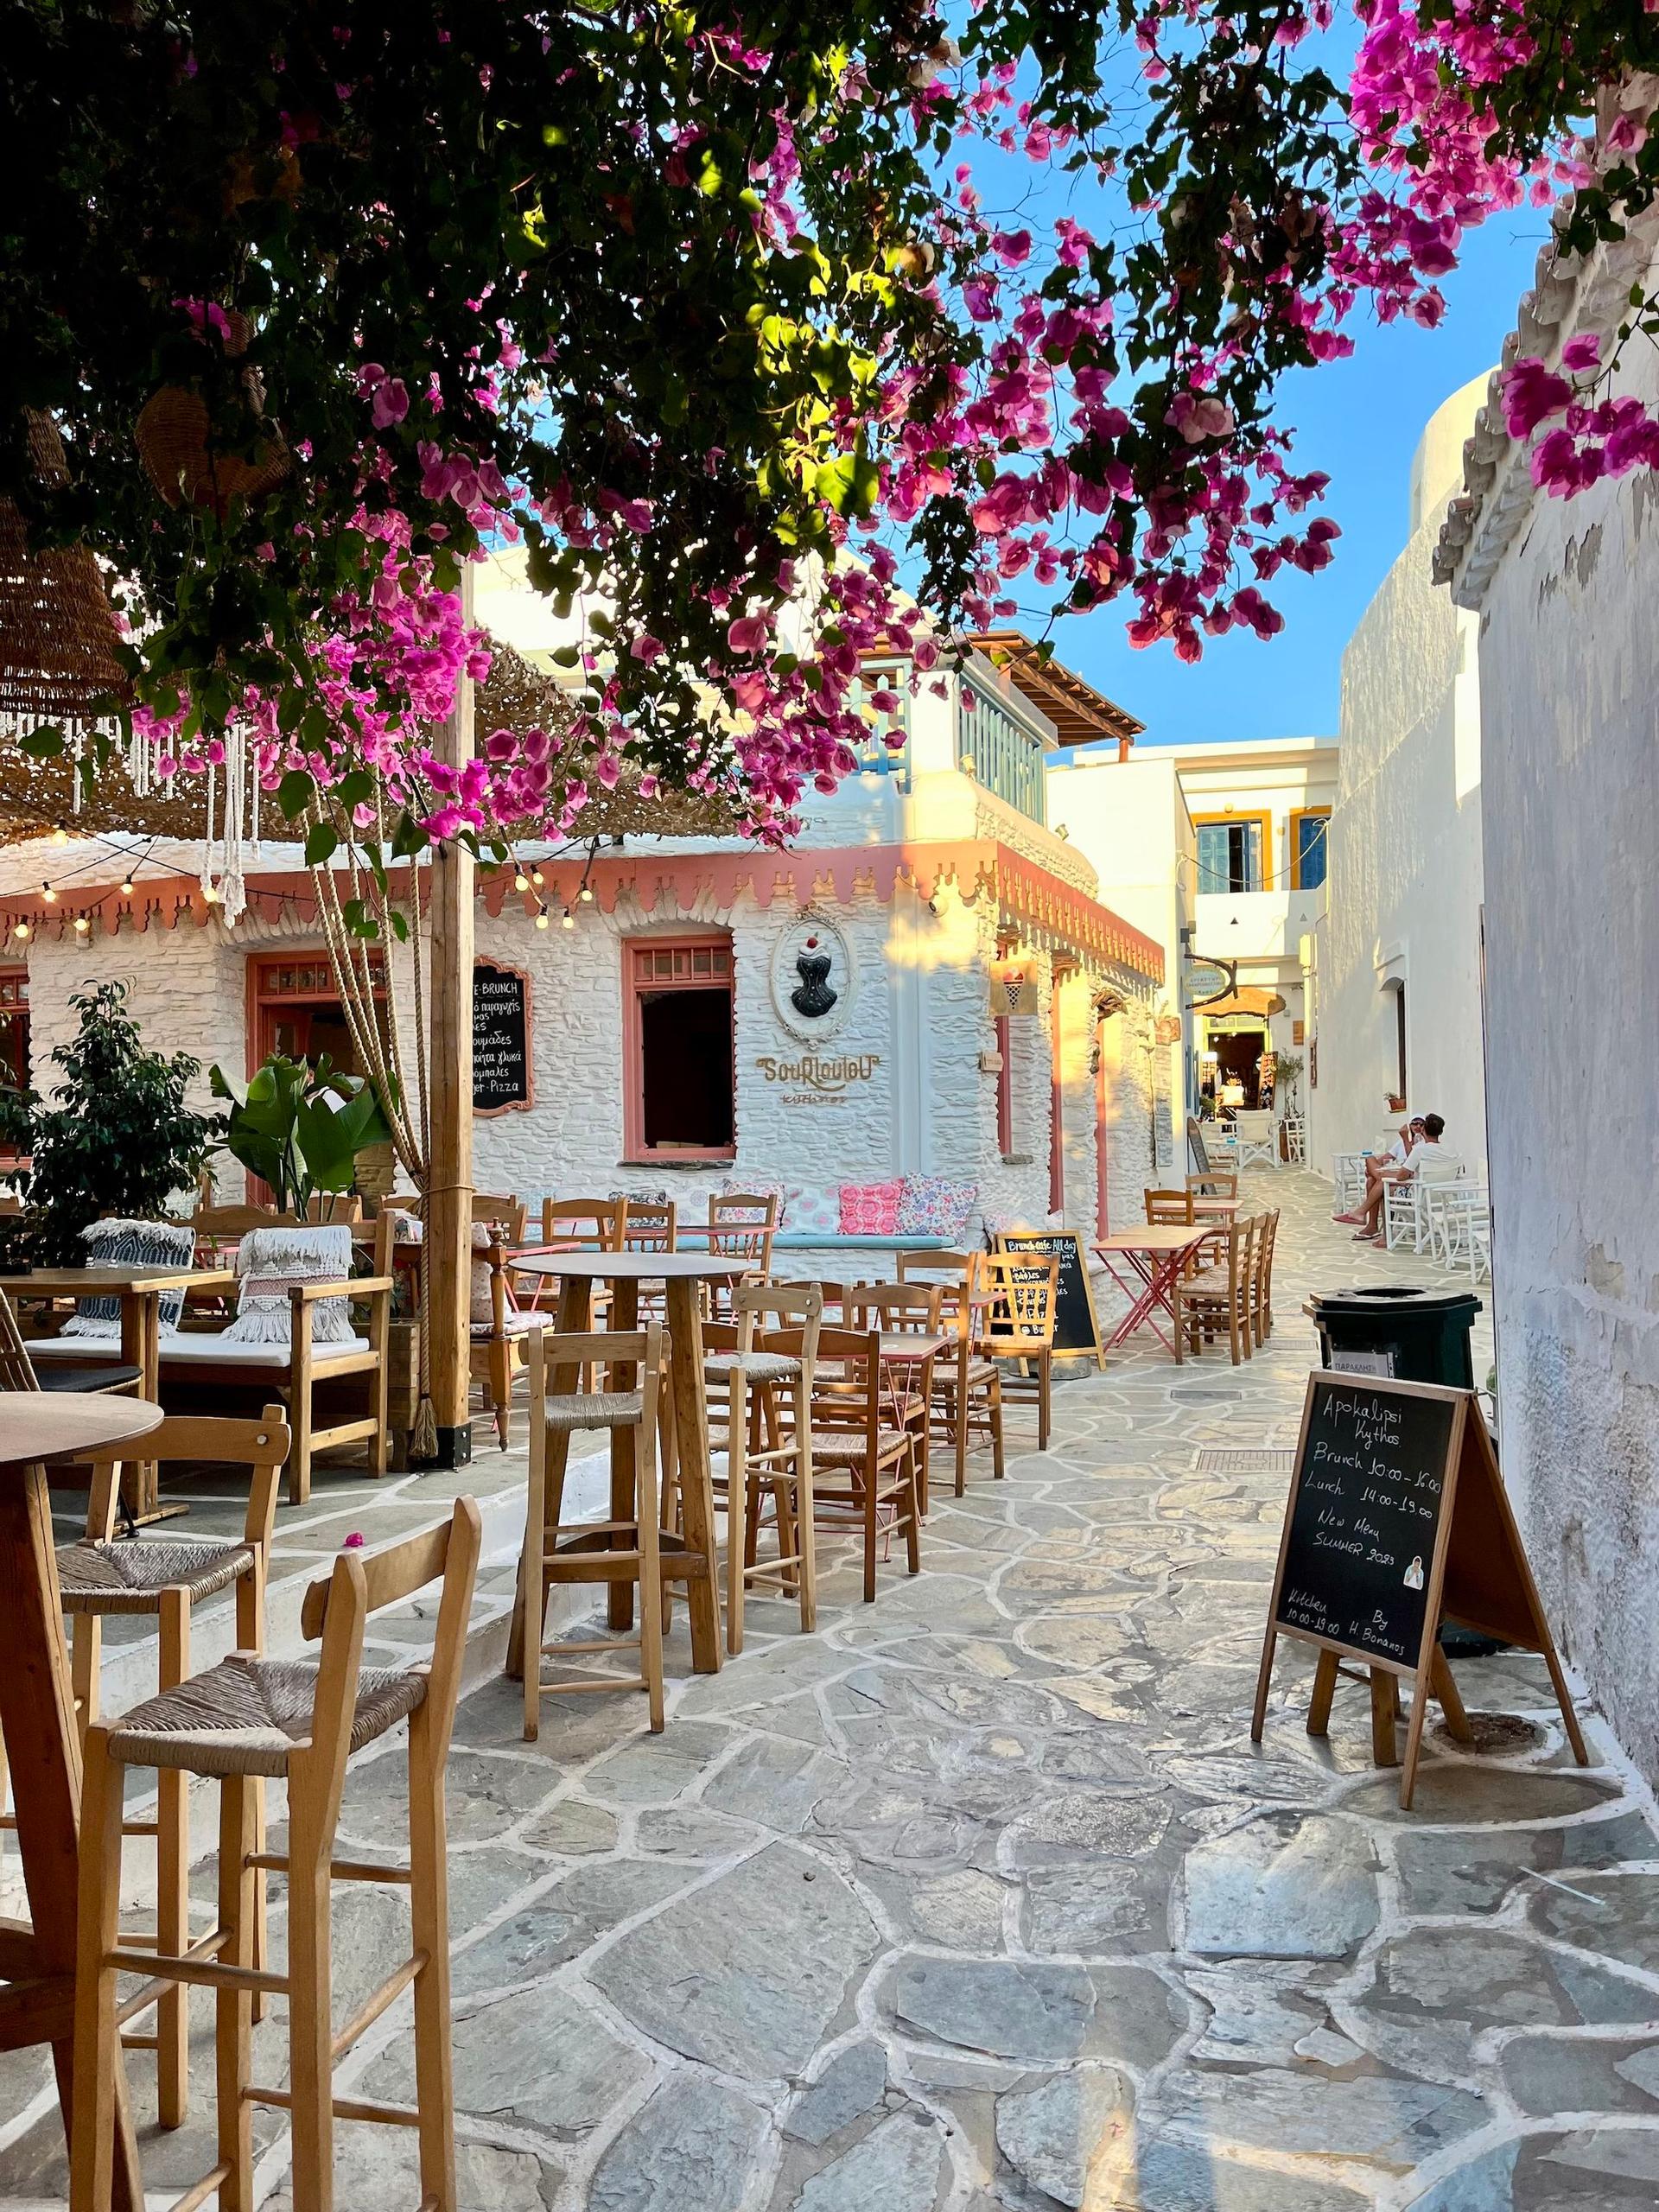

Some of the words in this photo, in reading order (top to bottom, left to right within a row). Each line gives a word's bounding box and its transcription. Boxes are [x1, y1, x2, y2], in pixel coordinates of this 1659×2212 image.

[1318, 1507, 1345, 1528] New
[1366, 1548, 1395, 1566] 2023
[1372, 1610, 1389, 1631] By
